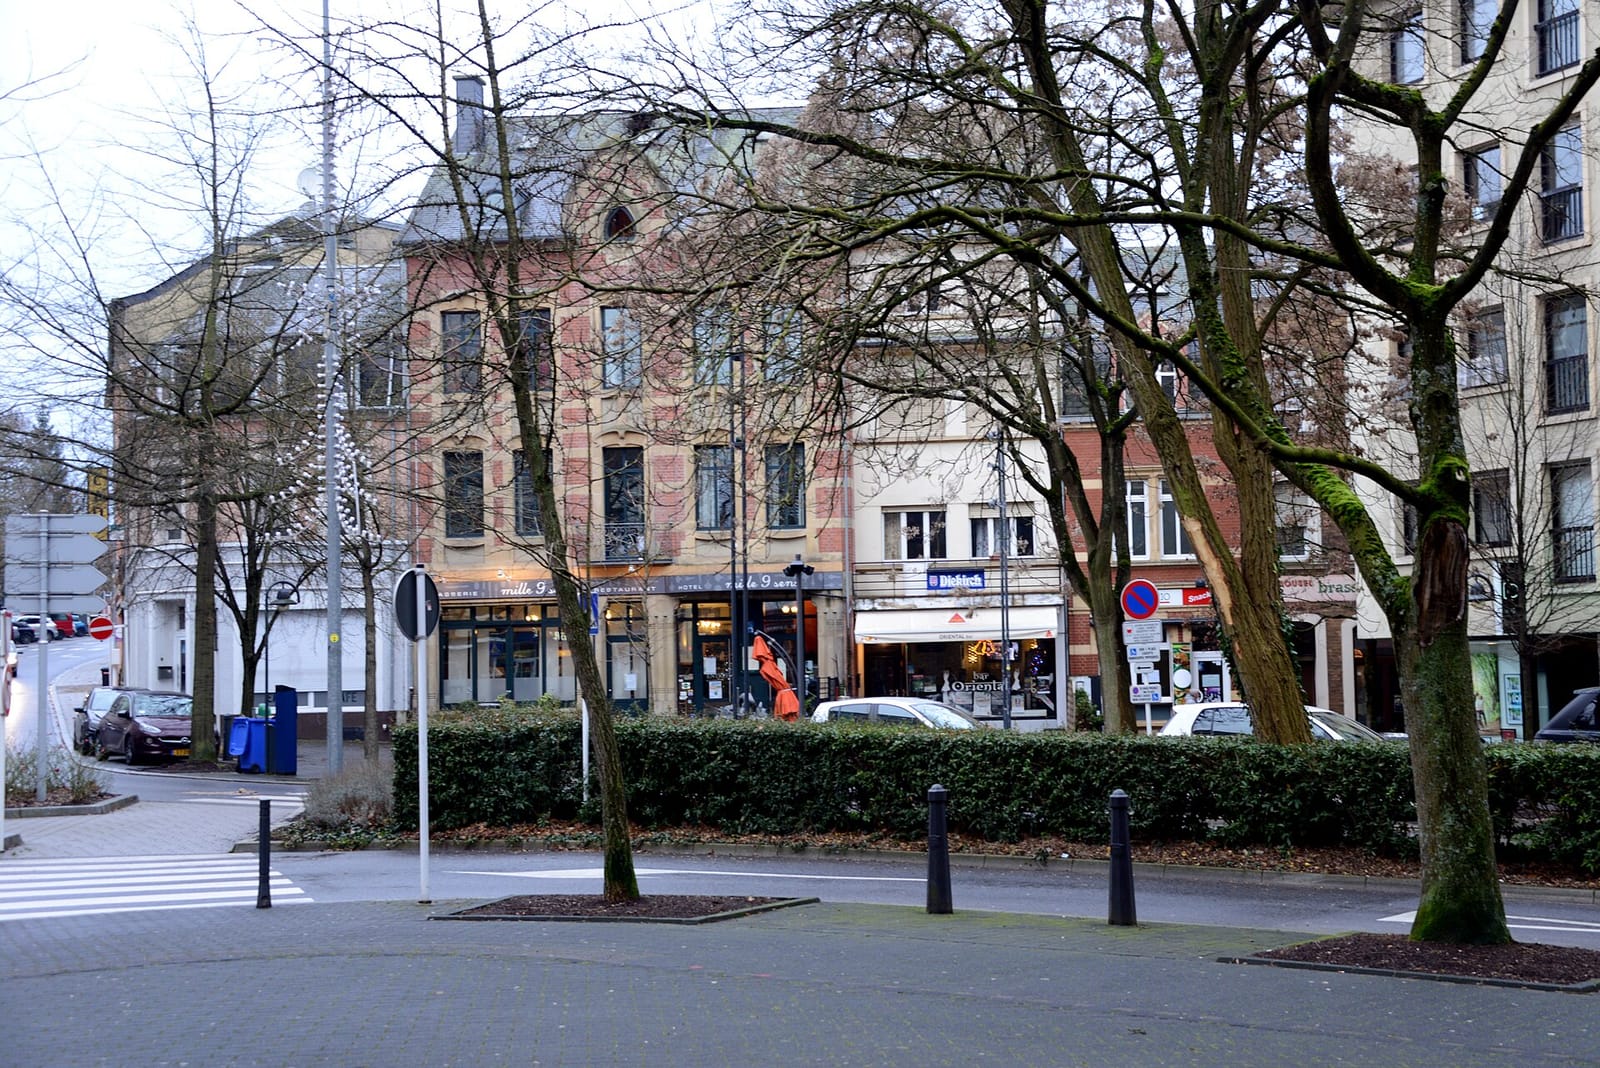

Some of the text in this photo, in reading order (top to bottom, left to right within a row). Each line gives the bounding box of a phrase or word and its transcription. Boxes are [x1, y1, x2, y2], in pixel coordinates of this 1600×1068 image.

[725, 576, 758, 589] mile
[760, 574, 771, 588] 9
[940, 573, 983, 587] Diekirch
[1319, 580, 1358, 593] brass
[501, 582, 533, 595] mille
[535, 581, 546, 594] 9
[973, 671, 989, 681] bar
[952, 680, 1004, 692] Orienta
